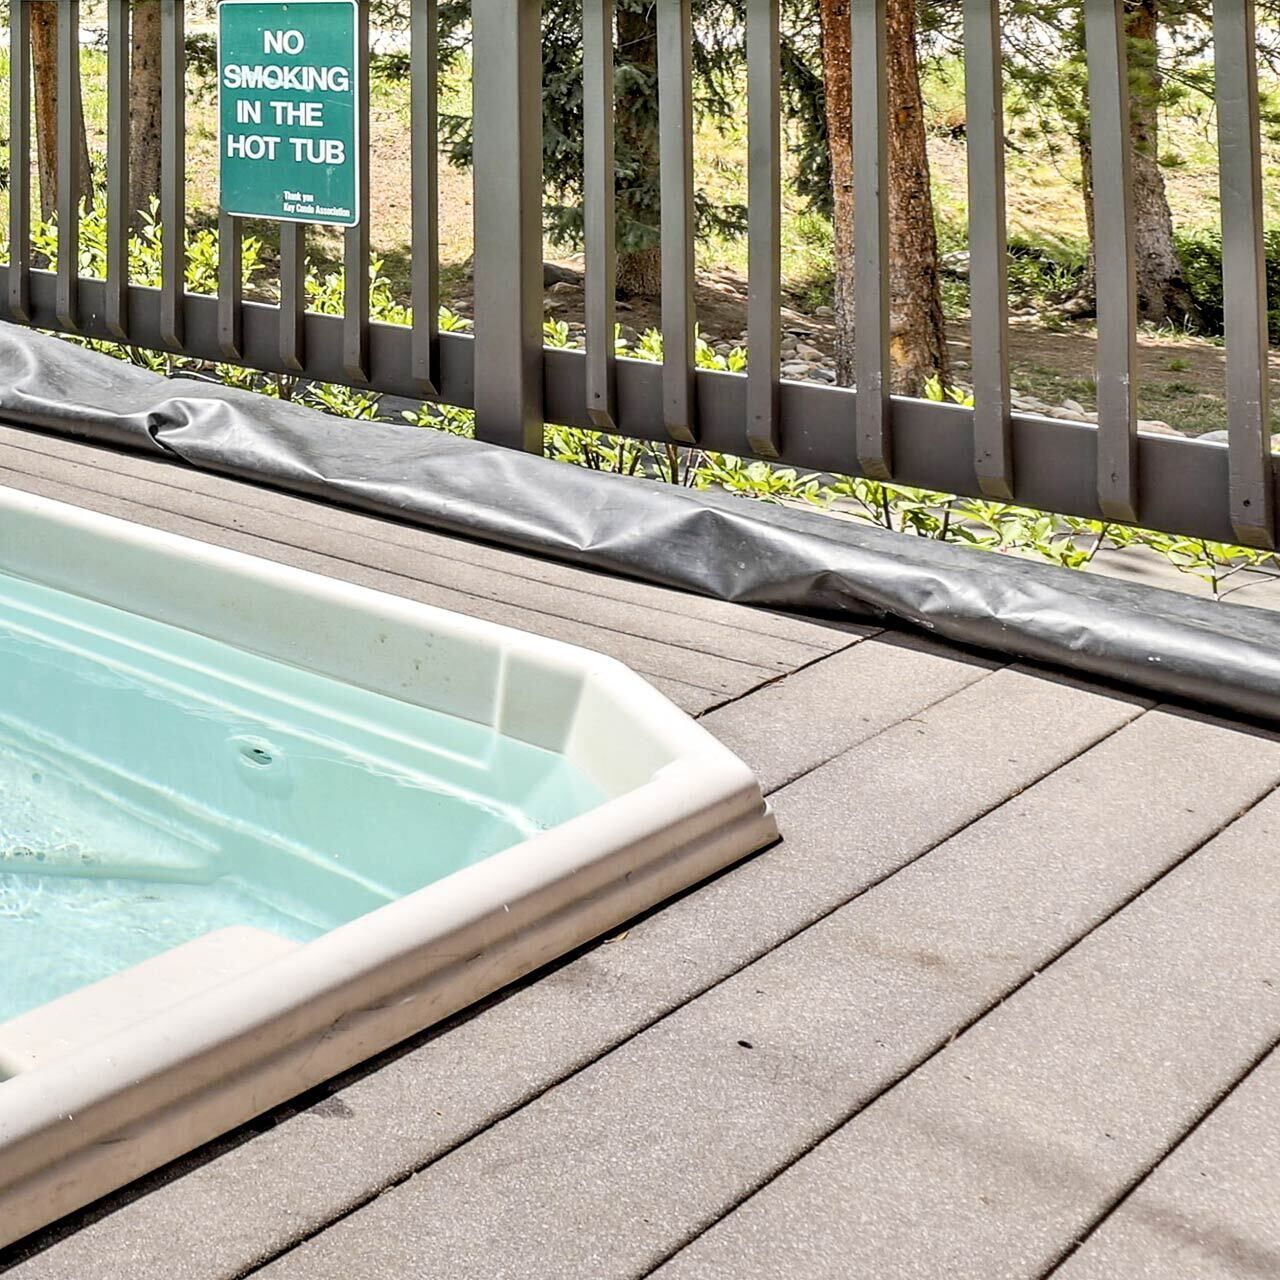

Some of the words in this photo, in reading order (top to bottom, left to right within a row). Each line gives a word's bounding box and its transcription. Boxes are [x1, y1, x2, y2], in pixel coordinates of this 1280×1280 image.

[264, 30, 304, 54] NO
[223, 64, 349, 92] SMOKING
[237, 100, 261, 124] IN
[270, 101, 323, 127] THE
[227, 134, 281, 160] HOT
[289, 138, 345, 164] TUB
[283, 190, 301, 201] Thank
[302, 194, 314, 202] you
[283, 202, 295, 213] Key
[316, 205, 350, 217] Association
